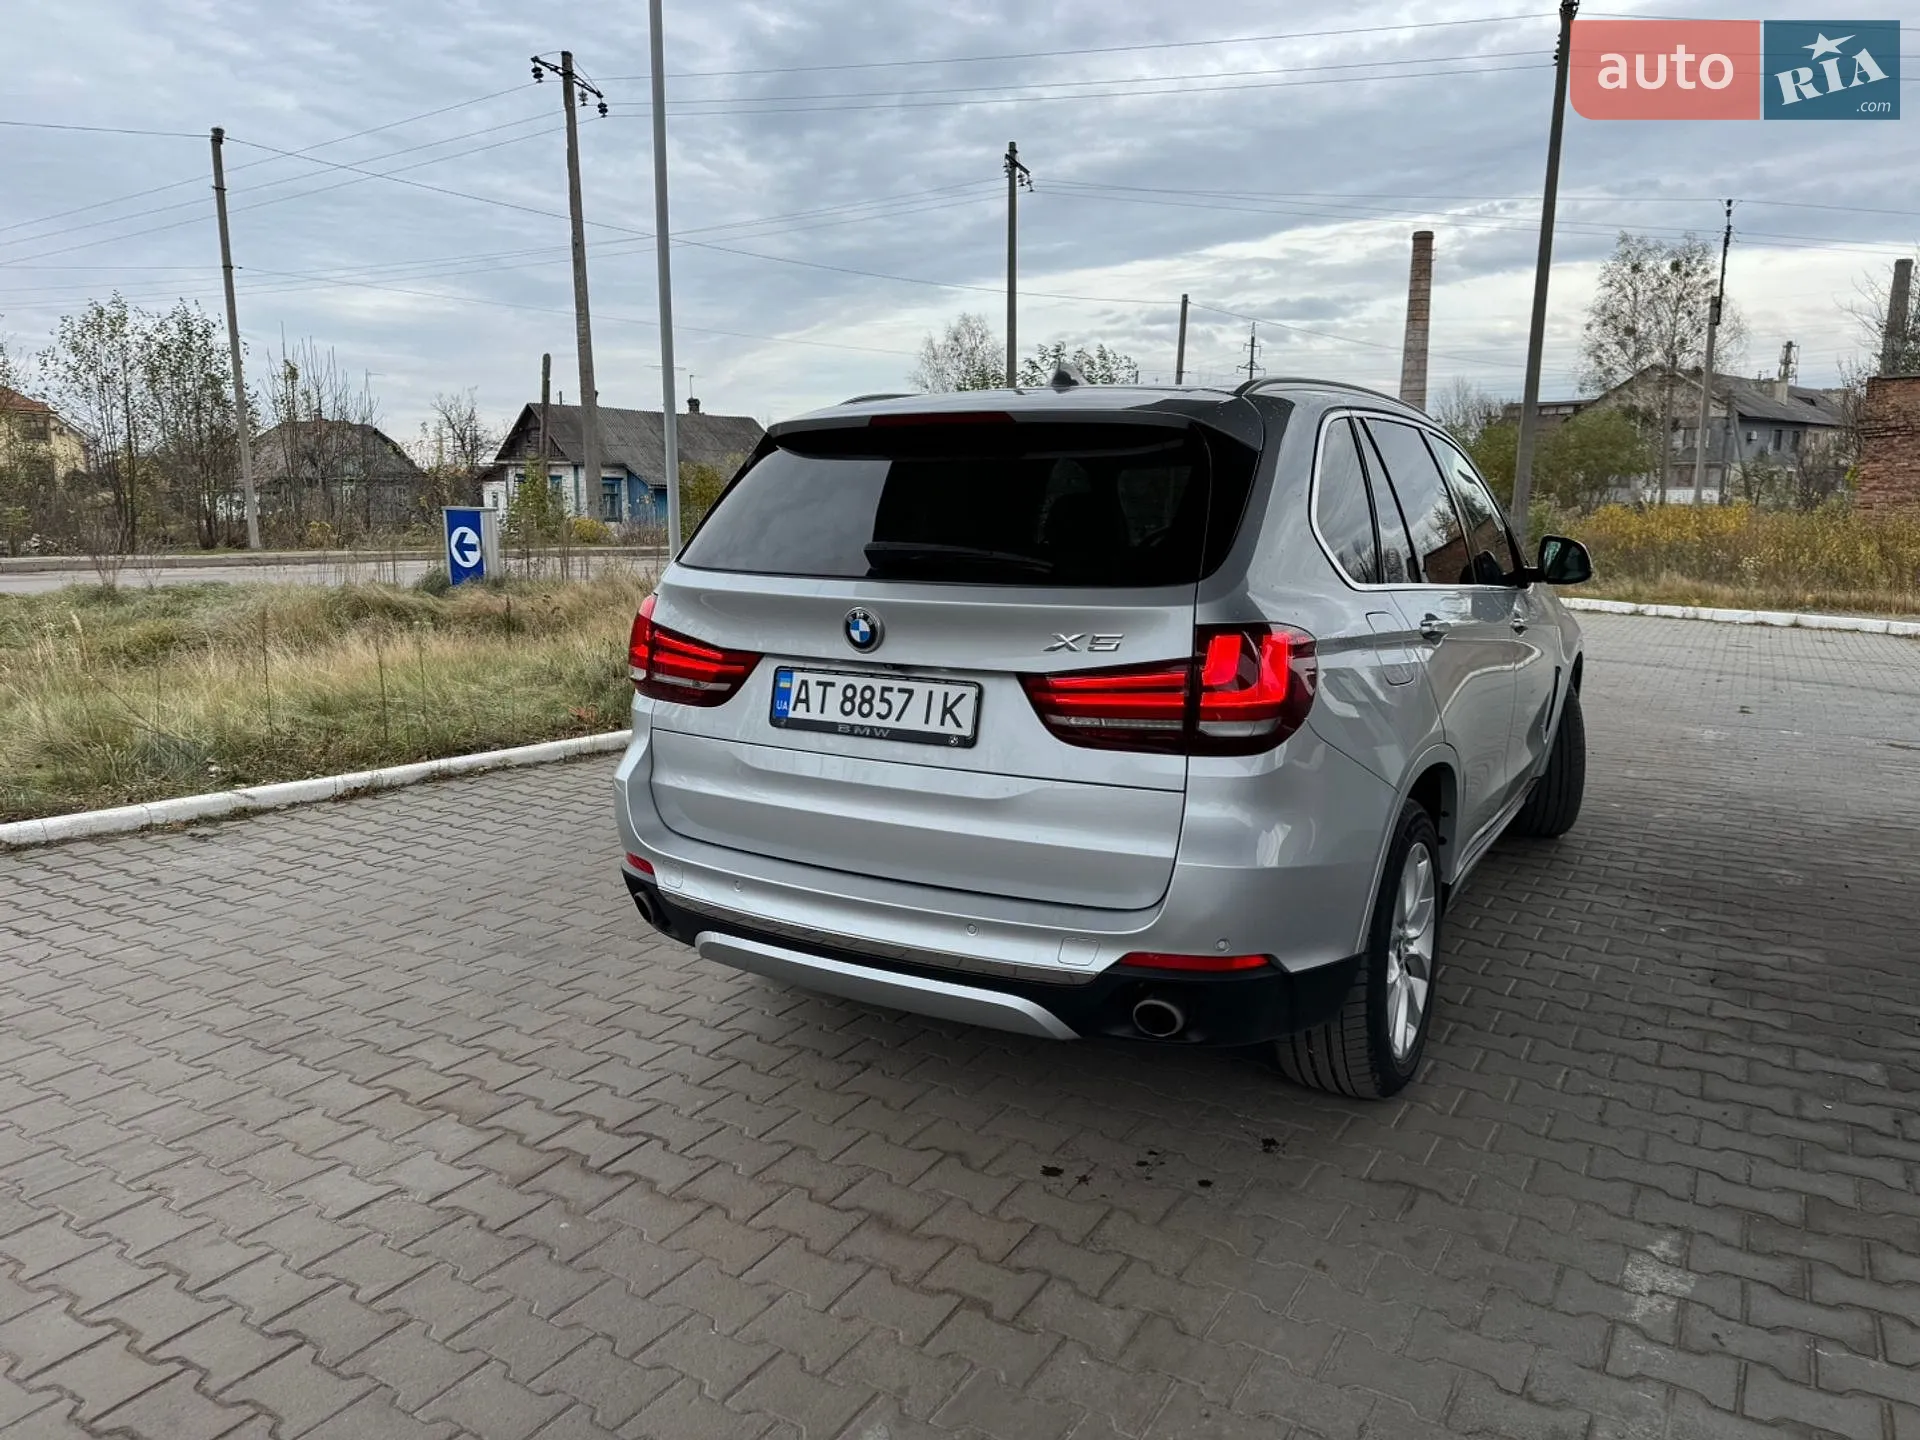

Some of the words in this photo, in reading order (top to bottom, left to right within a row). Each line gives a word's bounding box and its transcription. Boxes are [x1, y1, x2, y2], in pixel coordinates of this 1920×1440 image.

[1042, 632, 1125, 652] X5
[776, 700, 789, 711] UA
[792, 679, 836, 715] AT
[840, 683, 915, 722] 8857
[924, 690, 967, 729] IK
[837, 724, 890, 738] BMW
